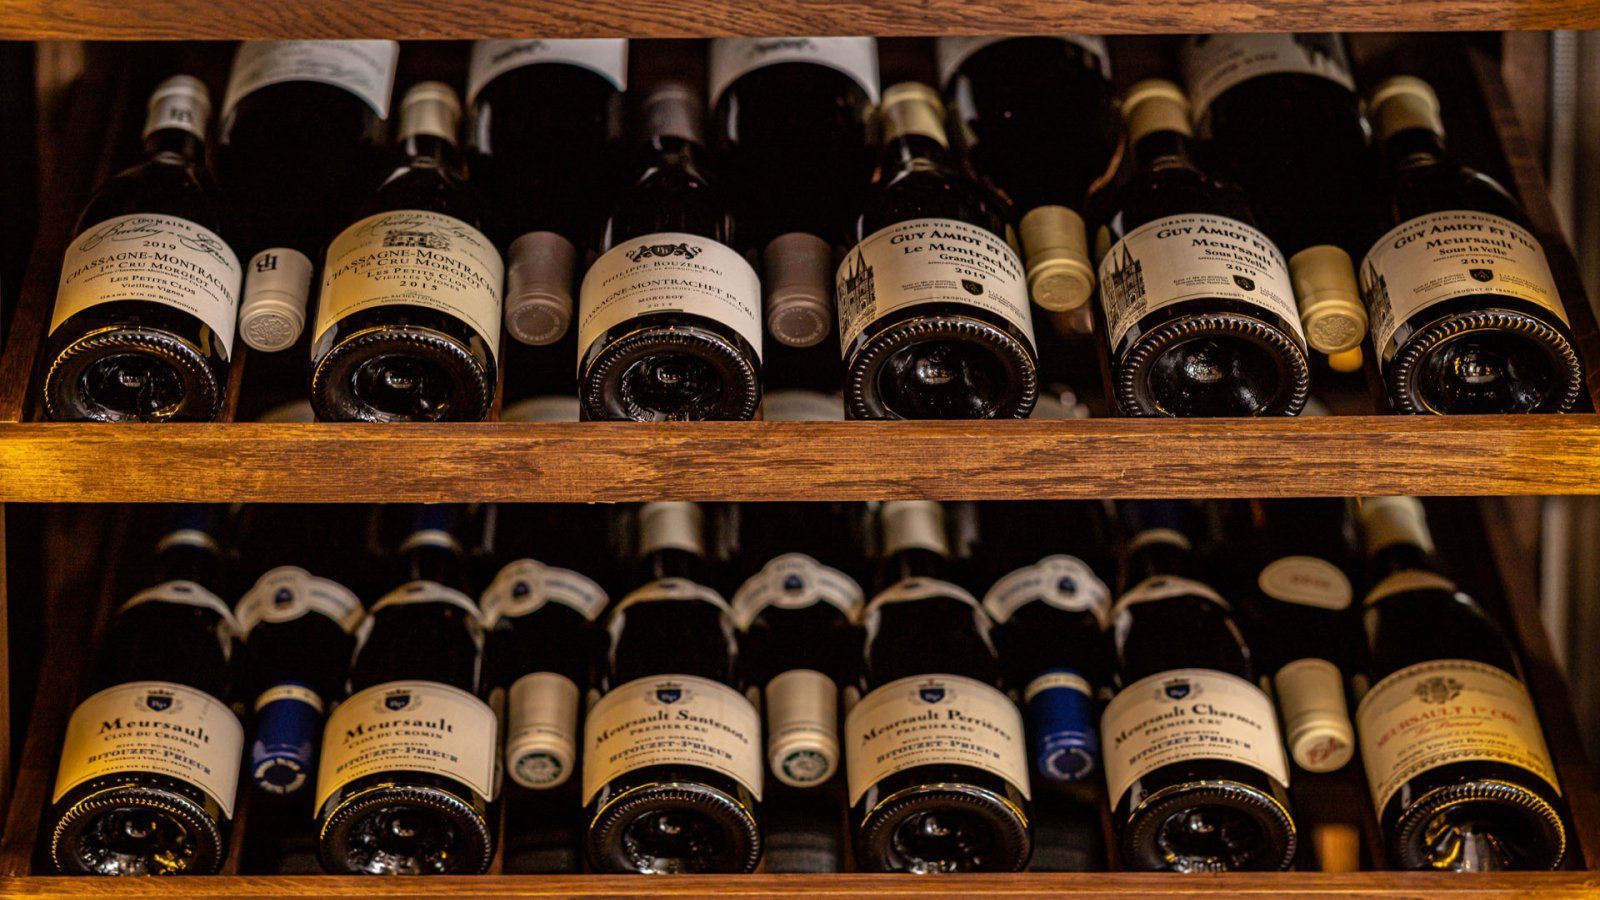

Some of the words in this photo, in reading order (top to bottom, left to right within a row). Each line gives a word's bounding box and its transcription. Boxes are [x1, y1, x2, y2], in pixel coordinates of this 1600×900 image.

[143, 240, 176, 250] 2019
[890, 231, 926, 245] GUY
[930, 230, 982, 247] AMIOT
[986, 243, 1000, 256] ET
[1156, 226, 1192, 239] GUY
[1197, 225, 1249, 243] AMIOT
[1394, 230, 1426, 249] GUY
[1430, 223, 1483, 235] AMIOT
[1489, 226, 1505, 236] ET
[1510, 231, 1536, 252] FILS
[1425, 236, 1514, 250] Meursault
[1192, 238, 1272, 268] Meursault
[1205, 248, 1232, 258] Sous
[1439, 246, 1467, 256] Sous
[1480, 245, 1508, 256] Velle
[377, 258, 410, 267] CRU
[415, 258, 481, 289] MORGEOT
[904, 246, 923, 255] Le
[929, 243, 1017, 282] Montrachet
[939, 253, 975, 265] Grand
[977, 261, 997, 274] Cru
[955, 267, 986, 280] 2019
[1226, 263, 1257, 276] 2019
[132, 274, 167, 284] PETITS
[170, 280, 197, 295] CLOS
[150, 262, 210, 288] MORGEOT
[394, 267, 435, 277] PETITS
[438, 273, 468, 290] CLOS
[602, 263, 650, 287] PHILIPPE
[654, 261, 723, 276] BOUZEREAU
[399, 280, 438, 291] 2015
[638, 294, 684, 303] MORGEOT
[97, 716, 210, 744] Meursault
[104, 731, 132, 741] CLOS
[342, 718, 454, 746] Meursault
[594, 709, 669, 750] Meursault
[684, 723, 709, 733] CRU
[861, 709, 938, 748] Meursault
[1115, 706, 1185, 751] Meursault
[1191, 703, 1263, 730] Charmes
